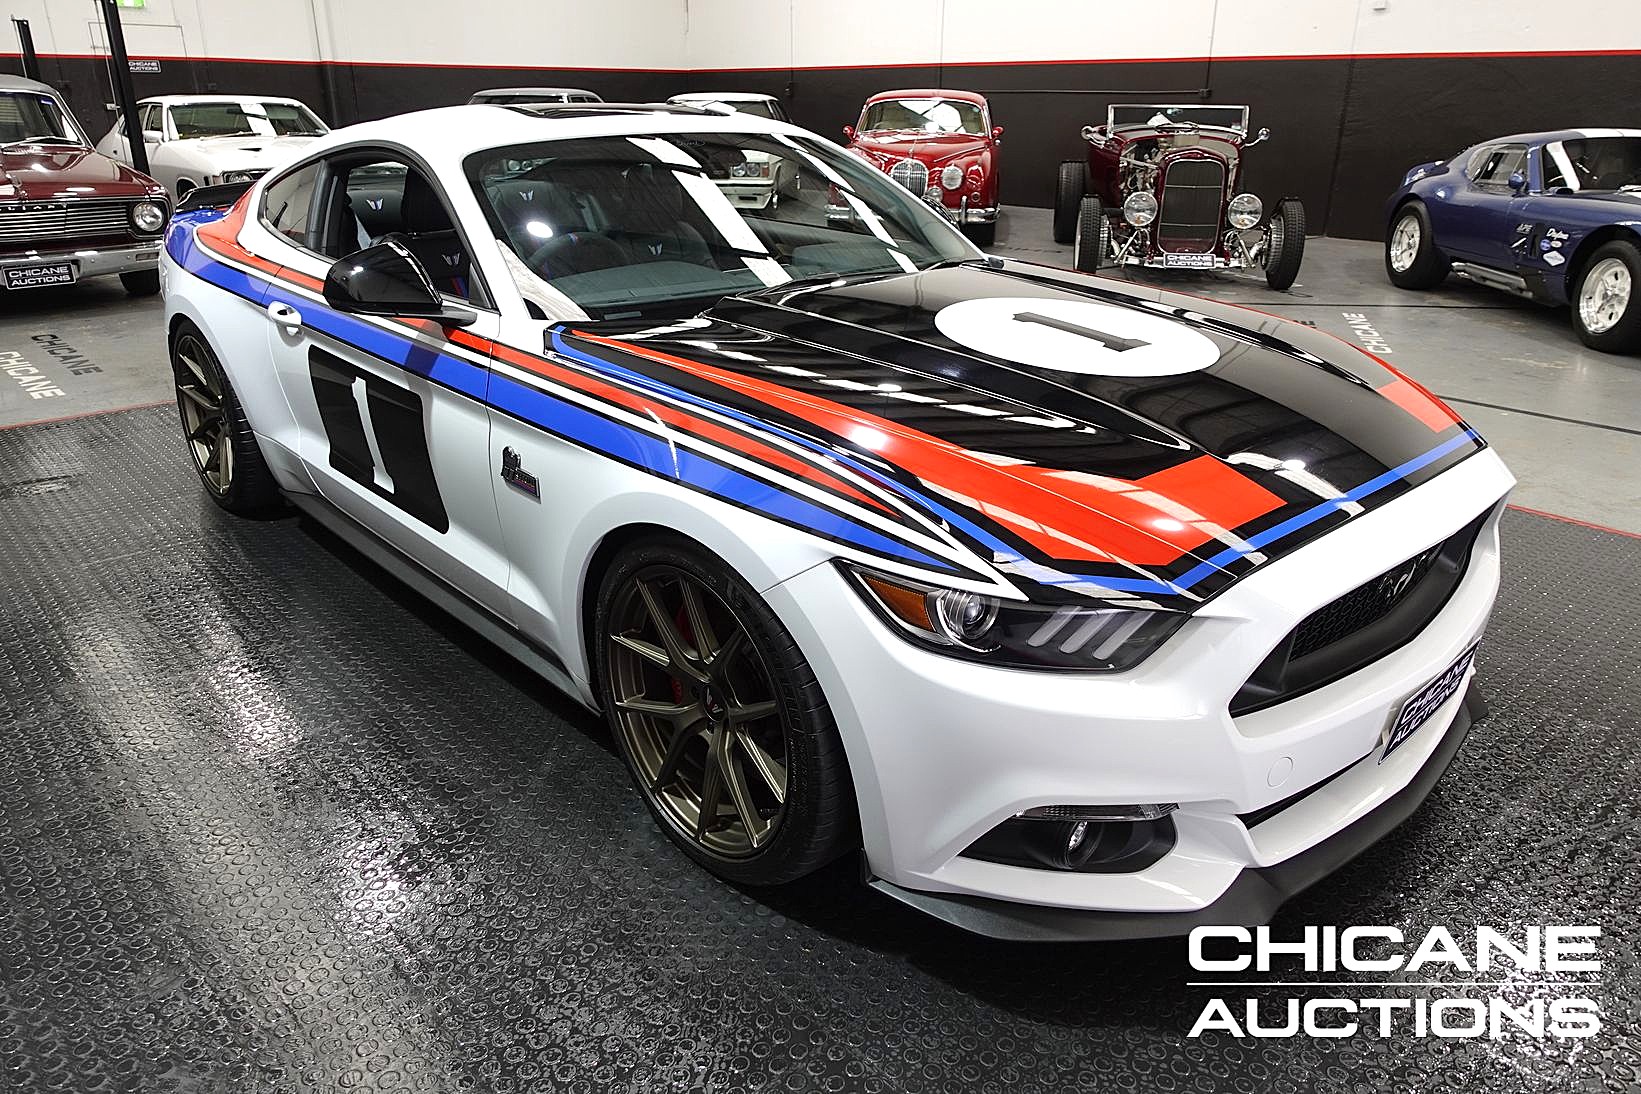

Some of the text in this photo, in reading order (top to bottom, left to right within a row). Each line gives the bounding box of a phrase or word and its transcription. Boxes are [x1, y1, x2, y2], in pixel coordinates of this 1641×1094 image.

[9, 266, 69, 278] CHICANE
[12, 275, 71, 287] AUCTIONS
[1012, 311, 1152, 352] 1
[1342, 312, 1393, 354] CHICANE
[0, 351, 67, 400] CHICANE
[31, 334, 104, 376] CHICANE
[352, 376, 395, 495] 1
[1400, 651, 1474, 725] CHICANE
[1388, 675, 1462, 750] AUCTIONS
